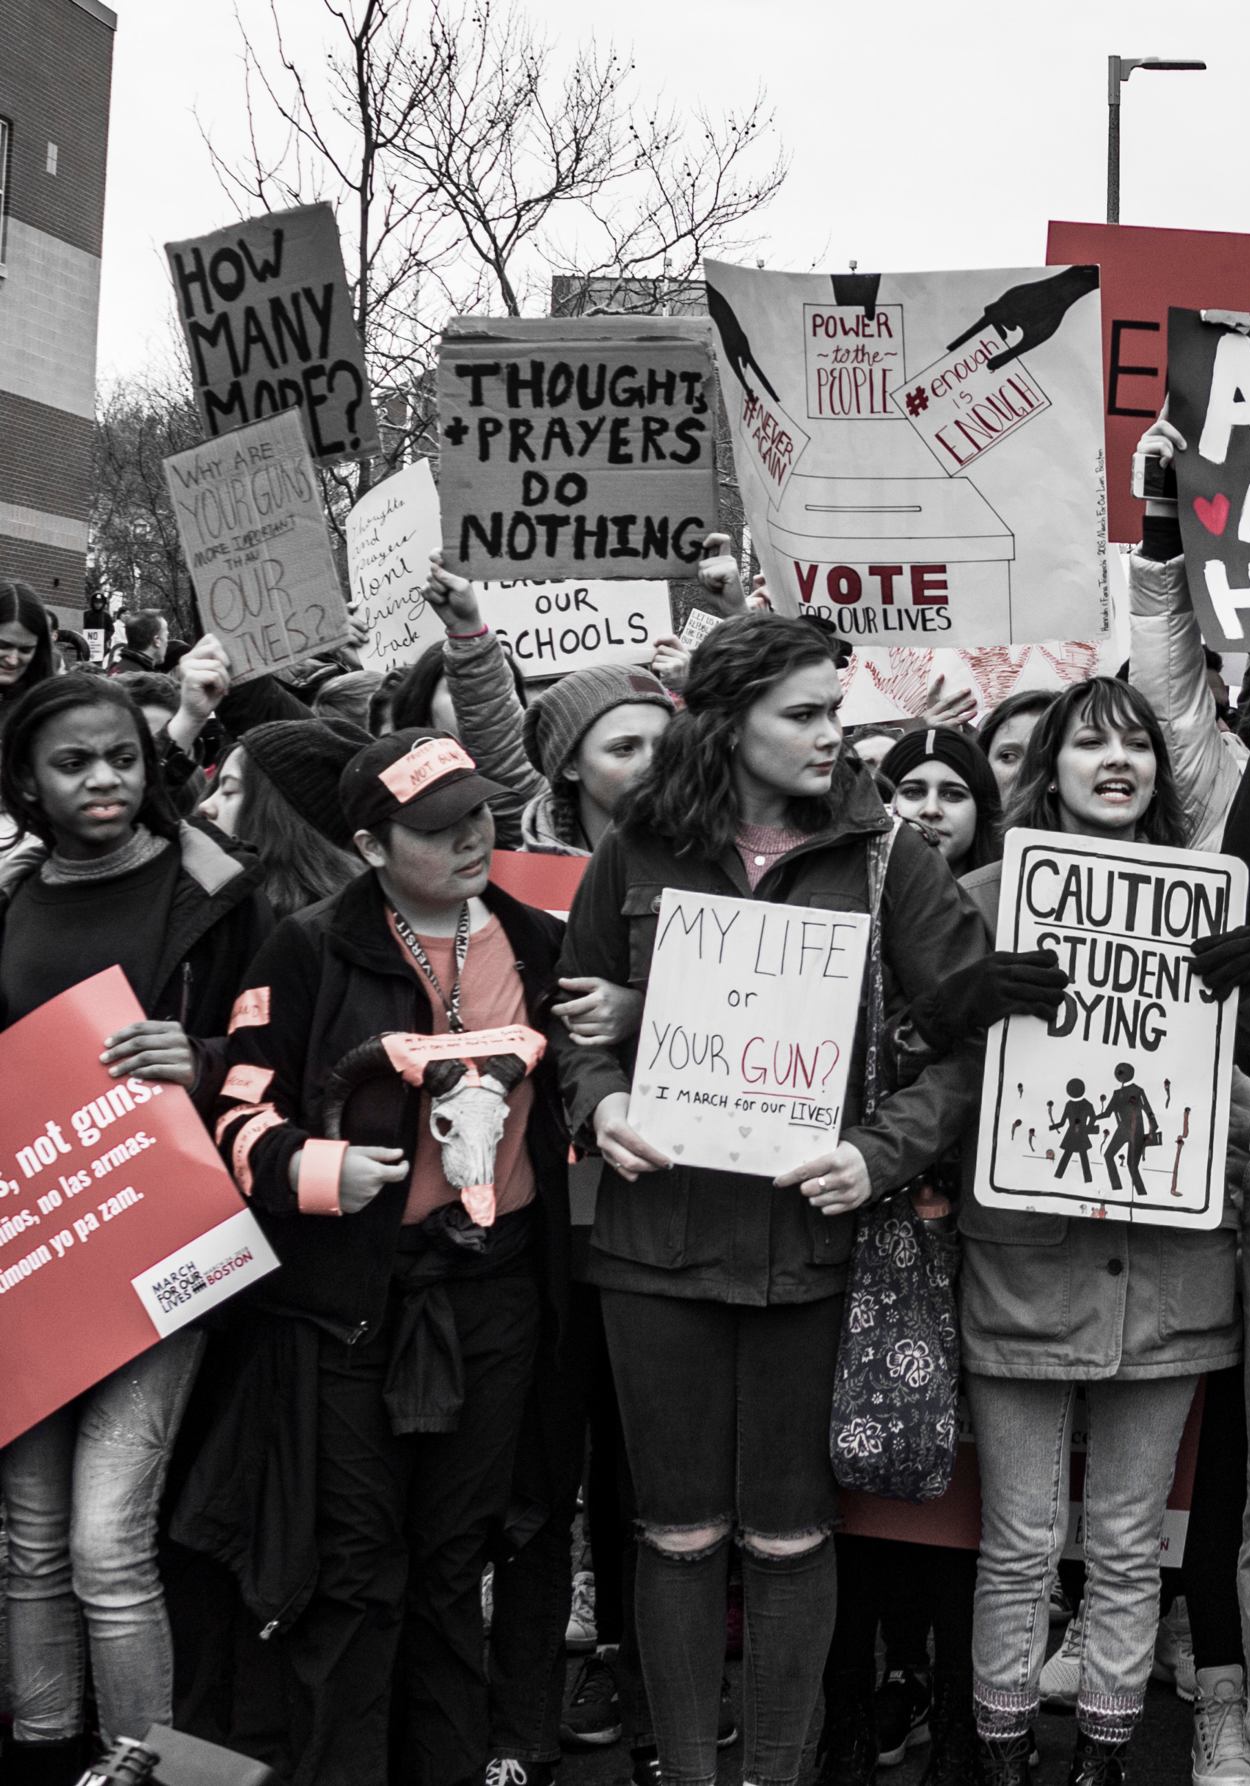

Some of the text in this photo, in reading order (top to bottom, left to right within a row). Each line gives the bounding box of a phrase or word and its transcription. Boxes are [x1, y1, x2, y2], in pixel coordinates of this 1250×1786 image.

[174, 228, 283, 319] HOW
[189, 282, 334, 386] MANY
[812, 312, 893, 338] POWER
[817, 367, 894, 416] PEOPLE
[934, 373, 1040, 465] ENOUGH
[172, 442, 275, 489] WHY ARE
[752, 426, 787, 486] AGAIN
[179, 458, 312, 545] YOUR GUNS
[522, 471, 587, 507] DO
[194, 543, 229, 569] MORE
[459, 511, 704, 563] NOTHING
[210, 558, 294, 633] OUR
[535, 588, 598, 615] OUR
[793, 561, 949, 605] VOTE
[495, 612, 649, 661] SCHOOLS
[837, 607, 878, 634] OUR
[883, 606, 951, 632] LIVES
[1026, 859, 1224, 939] CAUTION
[658, 904, 857, 978] MY LIFE
[1037, 932, 1216, 1004] STUDENT
[727, 989, 758, 1007] or
[1047, 990, 1167, 1052] DYING
[649, 1021, 840, 1093] YOUR GUN?
[15, 1120, 72, 1179] not
[71, 1076, 163, 1147] guns.
[656, 1086, 840, 1129] I MARCH for our LIVES!
[37, 1189, 63, 1215] no
[58, 1175, 91, 1198] las
[91, 1131, 157, 1178] armas.
[50, 1229, 74, 1258] yo
[72, 1213, 100, 1243] pa
[97, 1186, 145, 1222] zam.
[152, 1260, 197, 1295] MARCH
[157, 1270, 203, 1304] FOR OUR
[205, 1250, 253, 1286] BOSTON
[161, 1290, 192, 1314] LIVES
